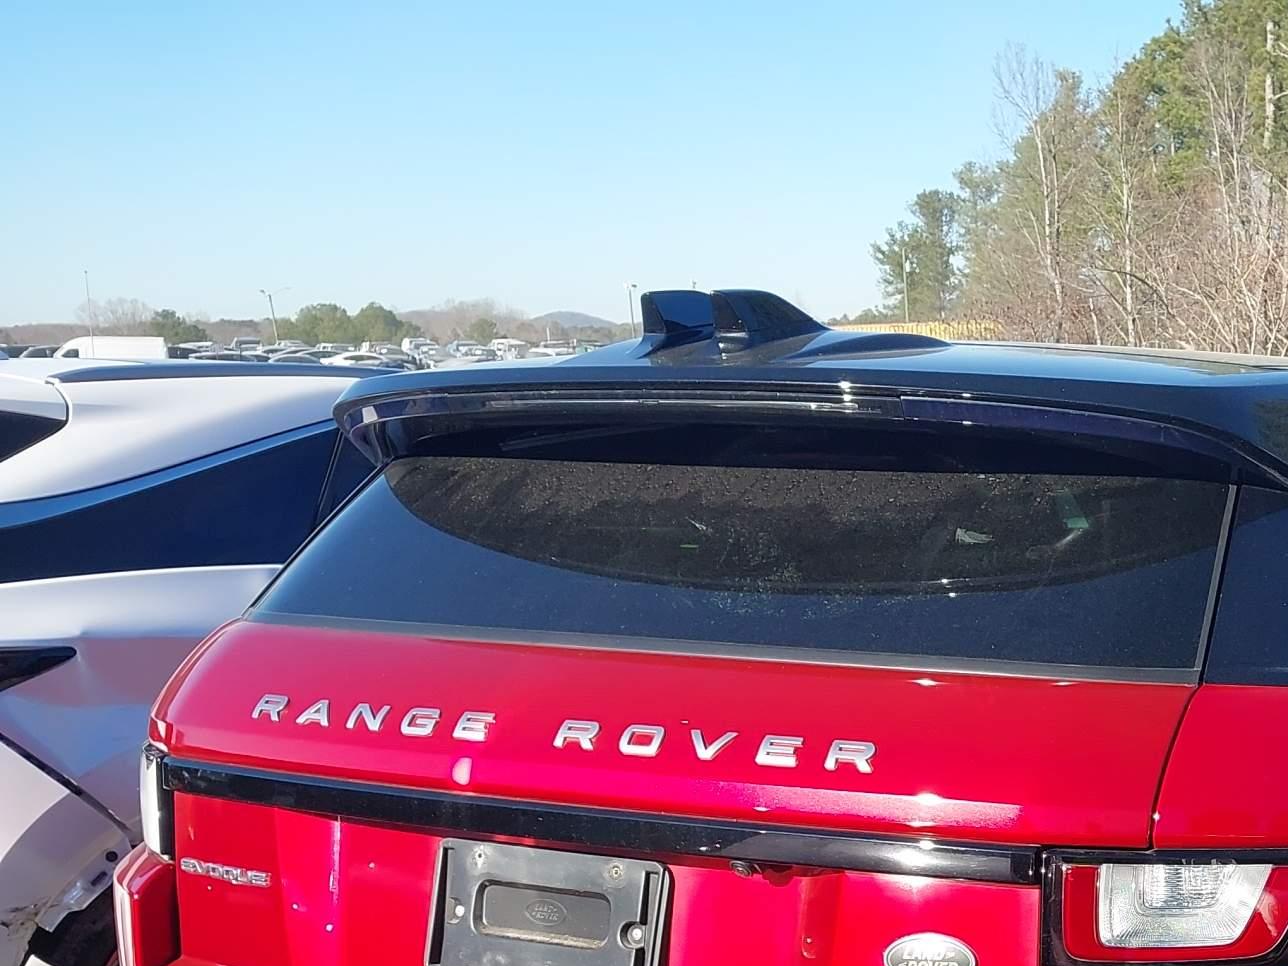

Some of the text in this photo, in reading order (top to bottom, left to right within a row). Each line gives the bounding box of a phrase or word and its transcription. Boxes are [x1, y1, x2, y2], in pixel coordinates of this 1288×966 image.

[251, 694, 878, 774] RANGE ROVER
[181, 857, 271, 888] EVOQUE
